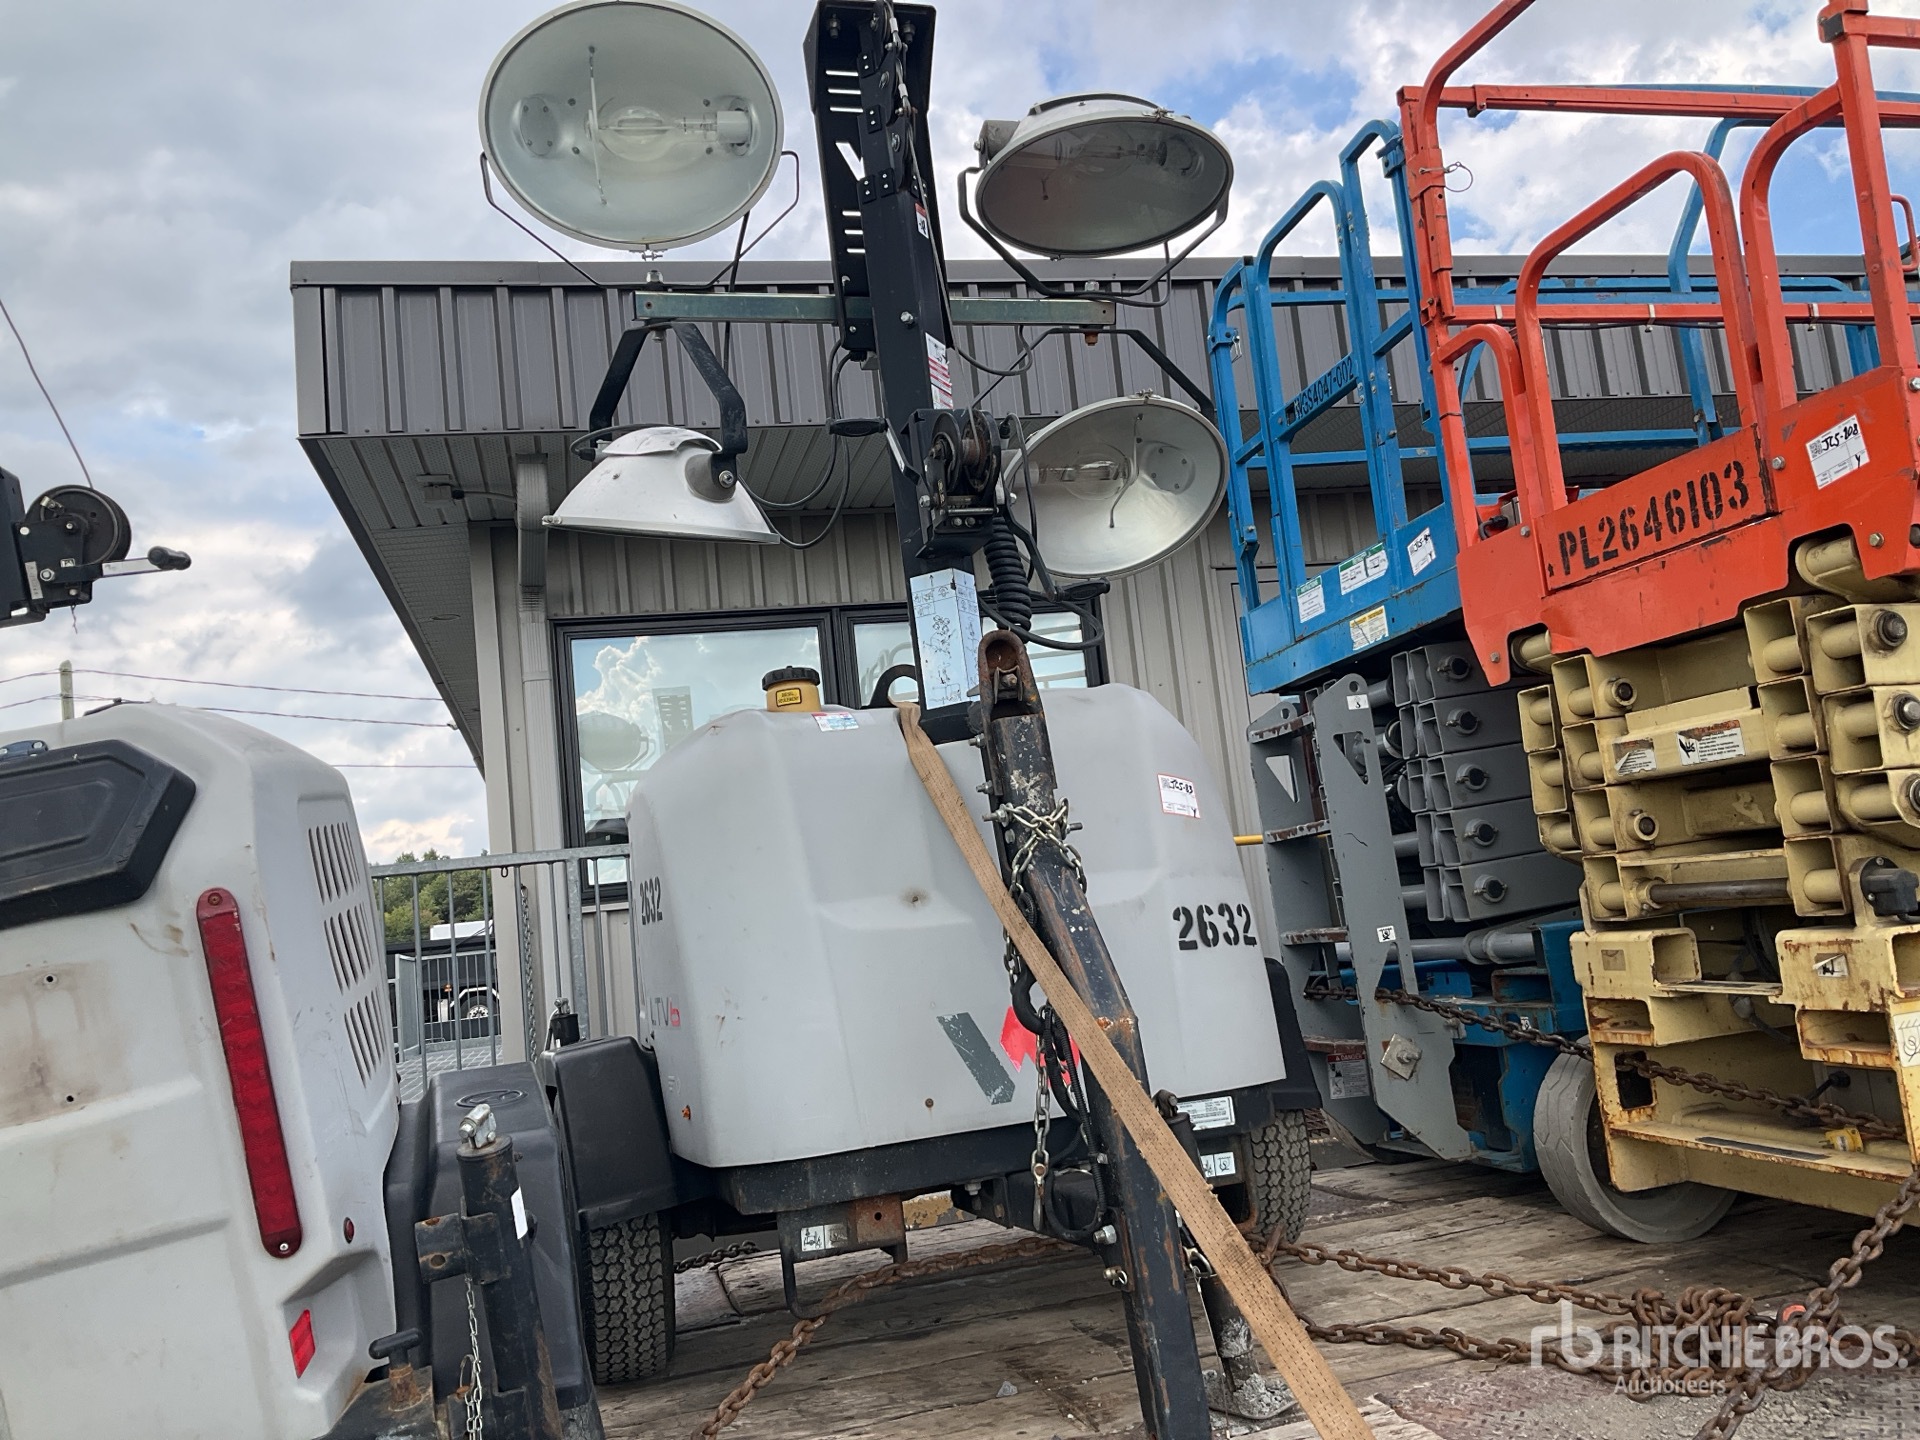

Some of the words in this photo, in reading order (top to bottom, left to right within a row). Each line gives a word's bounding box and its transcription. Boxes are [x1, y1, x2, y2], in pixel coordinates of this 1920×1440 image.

[1558, 460, 1749, 575] PL2646103
[639, 876, 663, 926] 2632
[1172, 902, 1258, 951] 2632
